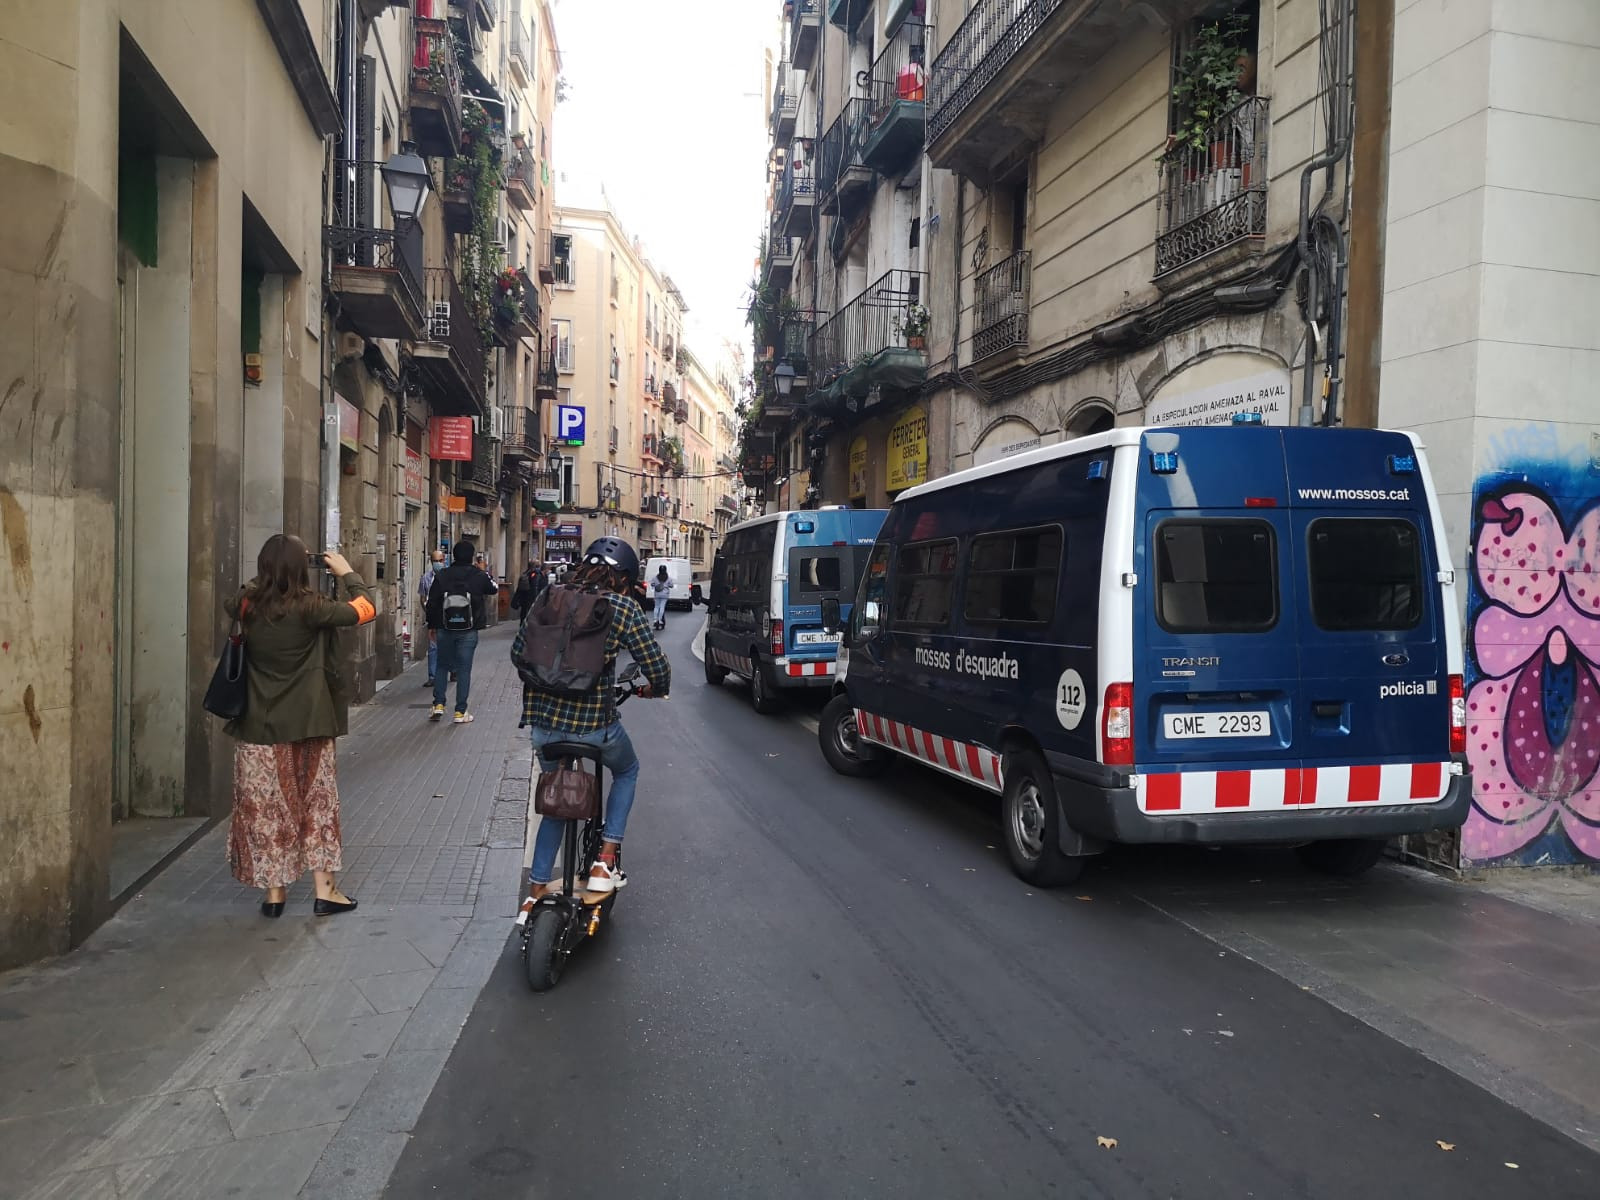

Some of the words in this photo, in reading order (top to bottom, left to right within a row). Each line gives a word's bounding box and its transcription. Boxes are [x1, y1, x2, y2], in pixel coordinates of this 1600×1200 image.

[1152, 414, 1161, 424] LA
[1210, 395, 1244, 410] AMENAZA
[1247, 392, 1256, 402] AL
[1259, 385, 1286, 400] RAVAL
[562, 407, 583, 437] P
[1298, 487, 1410, 500] www.mossos.cat
[801, 634, 817, 642] CME
[915, 647, 950, 670] mossos
[956, 648, 1019, 680] d'esquadra
[1161, 656, 1221, 667] TRANSIT
[1061, 684, 1081, 706] 112
[1380, 681, 1425, 699] policia
[1172, 716, 1206, 735] CME
[1218, 715, 1262, 733] 2293
